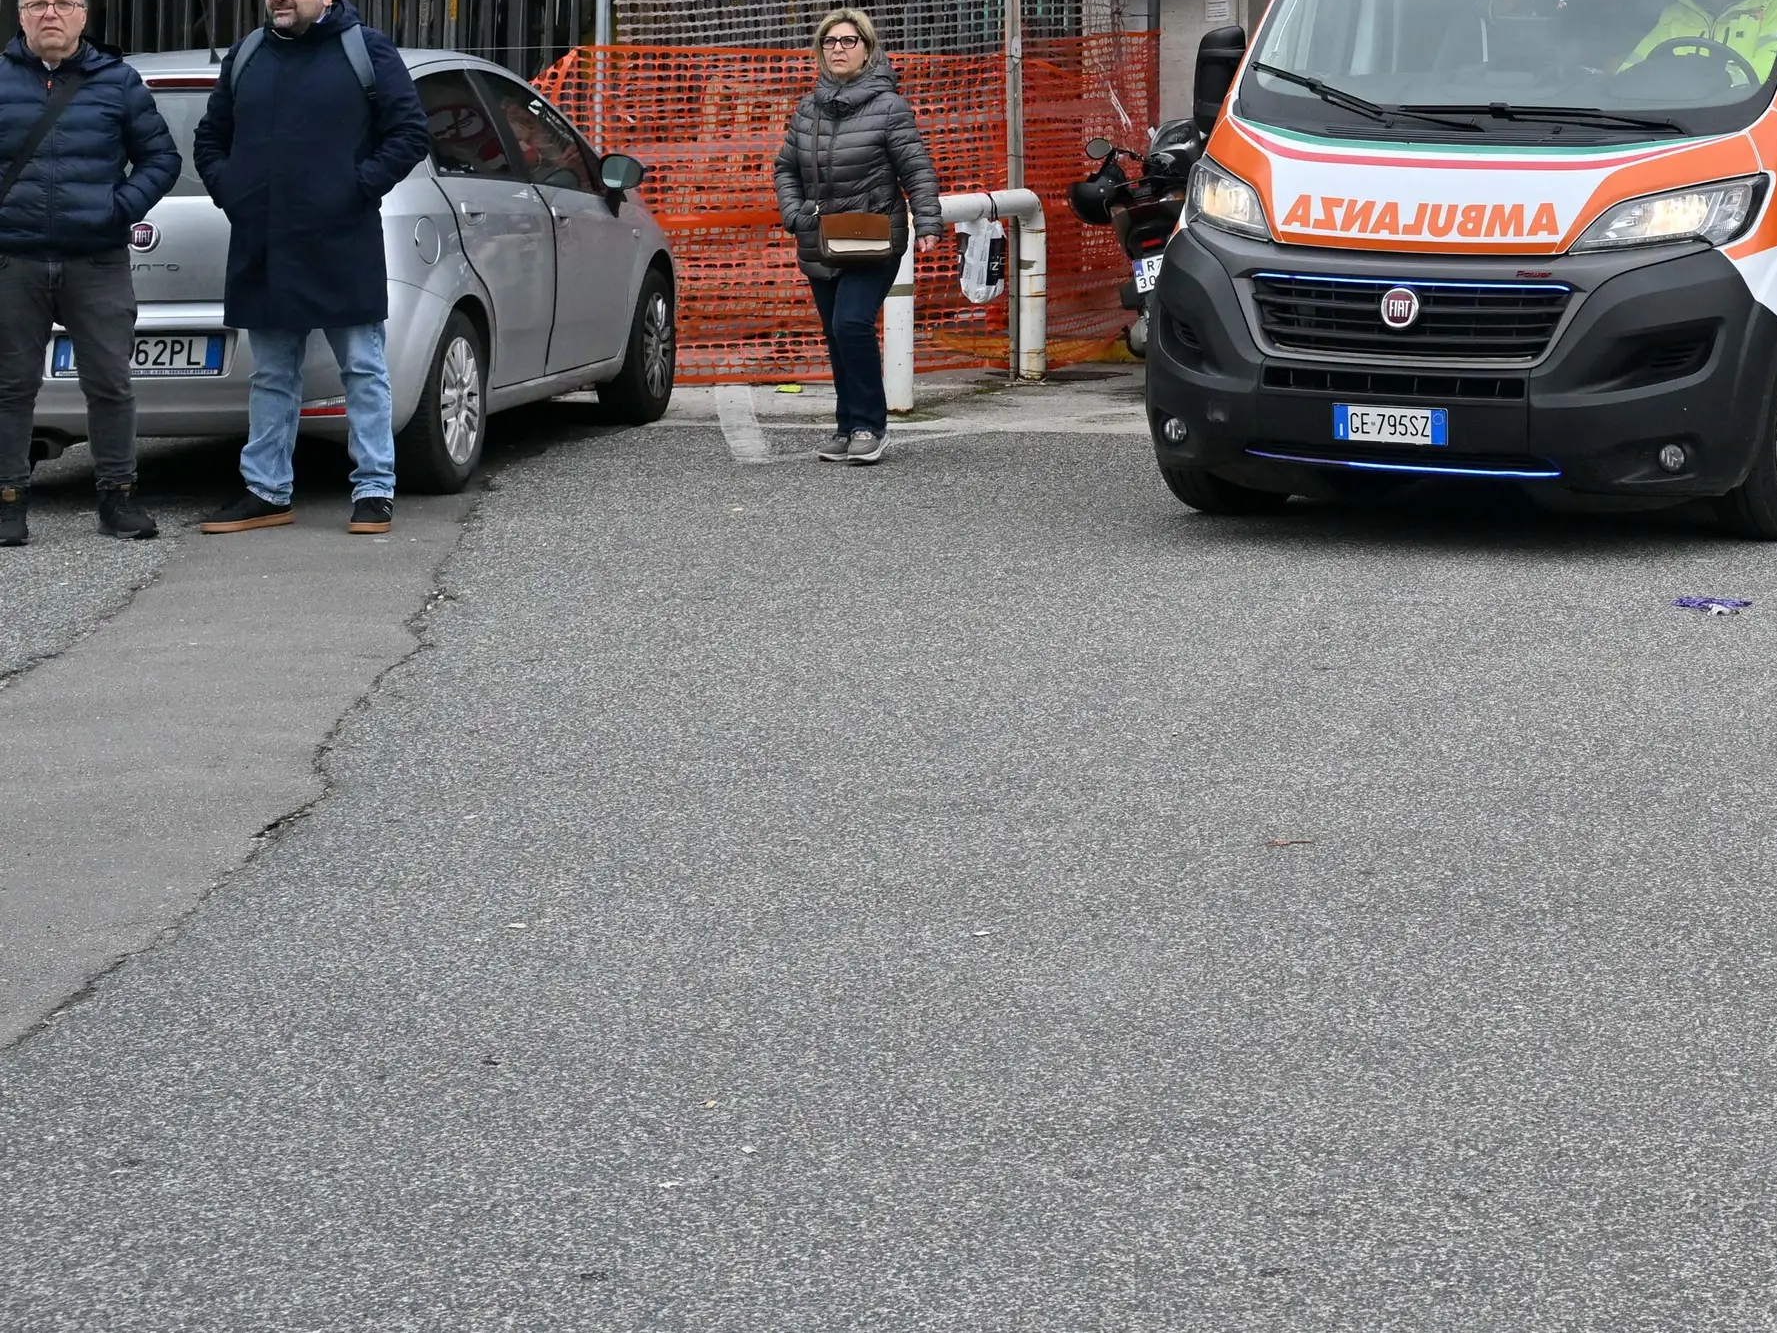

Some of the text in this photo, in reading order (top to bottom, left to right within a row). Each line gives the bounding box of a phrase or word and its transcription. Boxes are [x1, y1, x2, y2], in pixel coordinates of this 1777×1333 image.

[135, 229, 151, 244] FIAT
[1389, 299, 1411, 317] FIAT
[130, 339, 201, 366] 62PL
